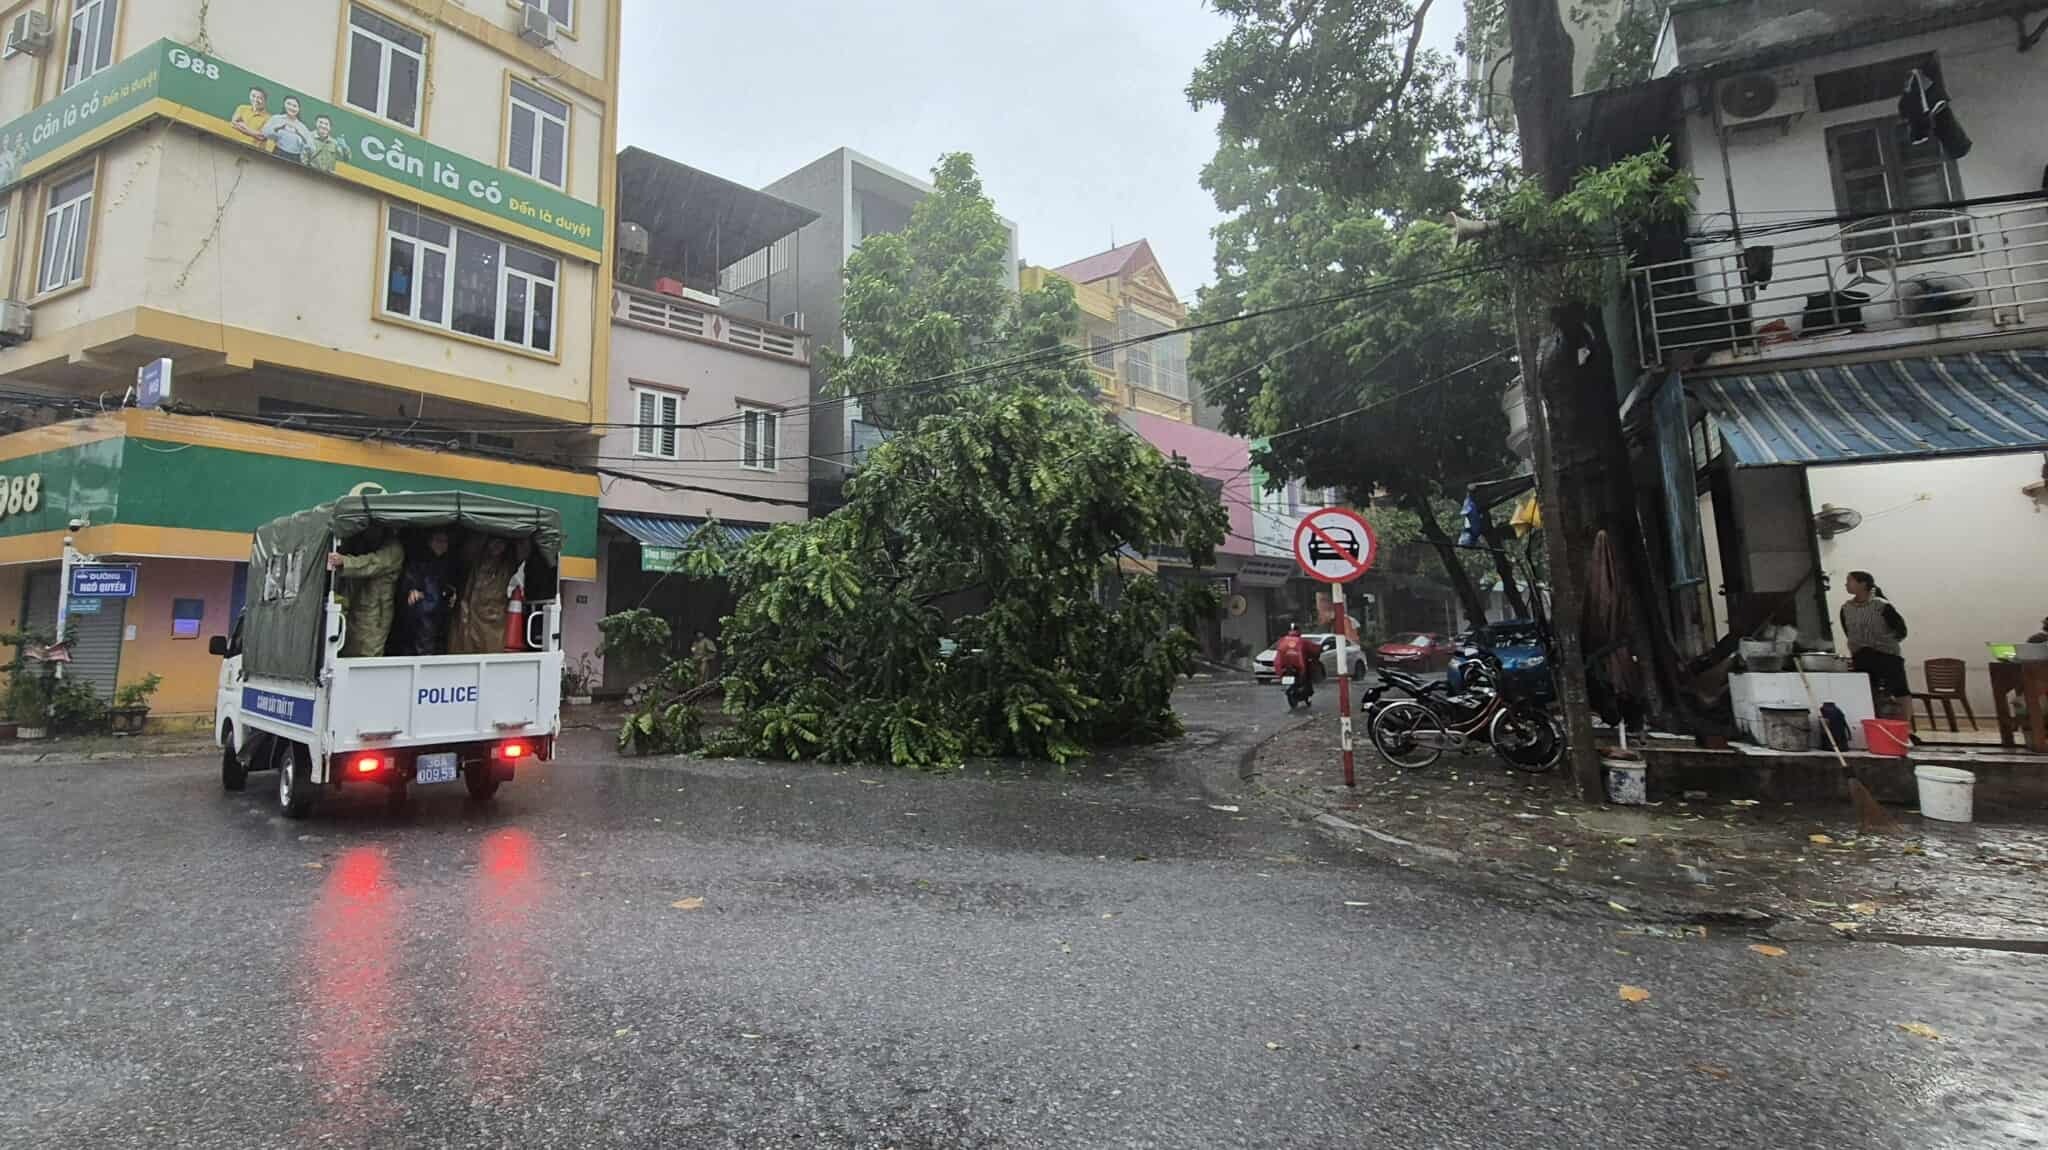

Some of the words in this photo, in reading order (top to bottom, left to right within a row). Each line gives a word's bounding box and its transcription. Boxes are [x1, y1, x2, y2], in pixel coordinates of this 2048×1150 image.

[361, 135, 424, 177] Cần
[433, 161, 460, 191] là
[467, 180, 503, 205] có
[508, 197, 537, 218] Đến
[539, 208, 553, 224] là
[555, 216, 592, 239] duyệt
[417, 685, 478, 705] POLICE
